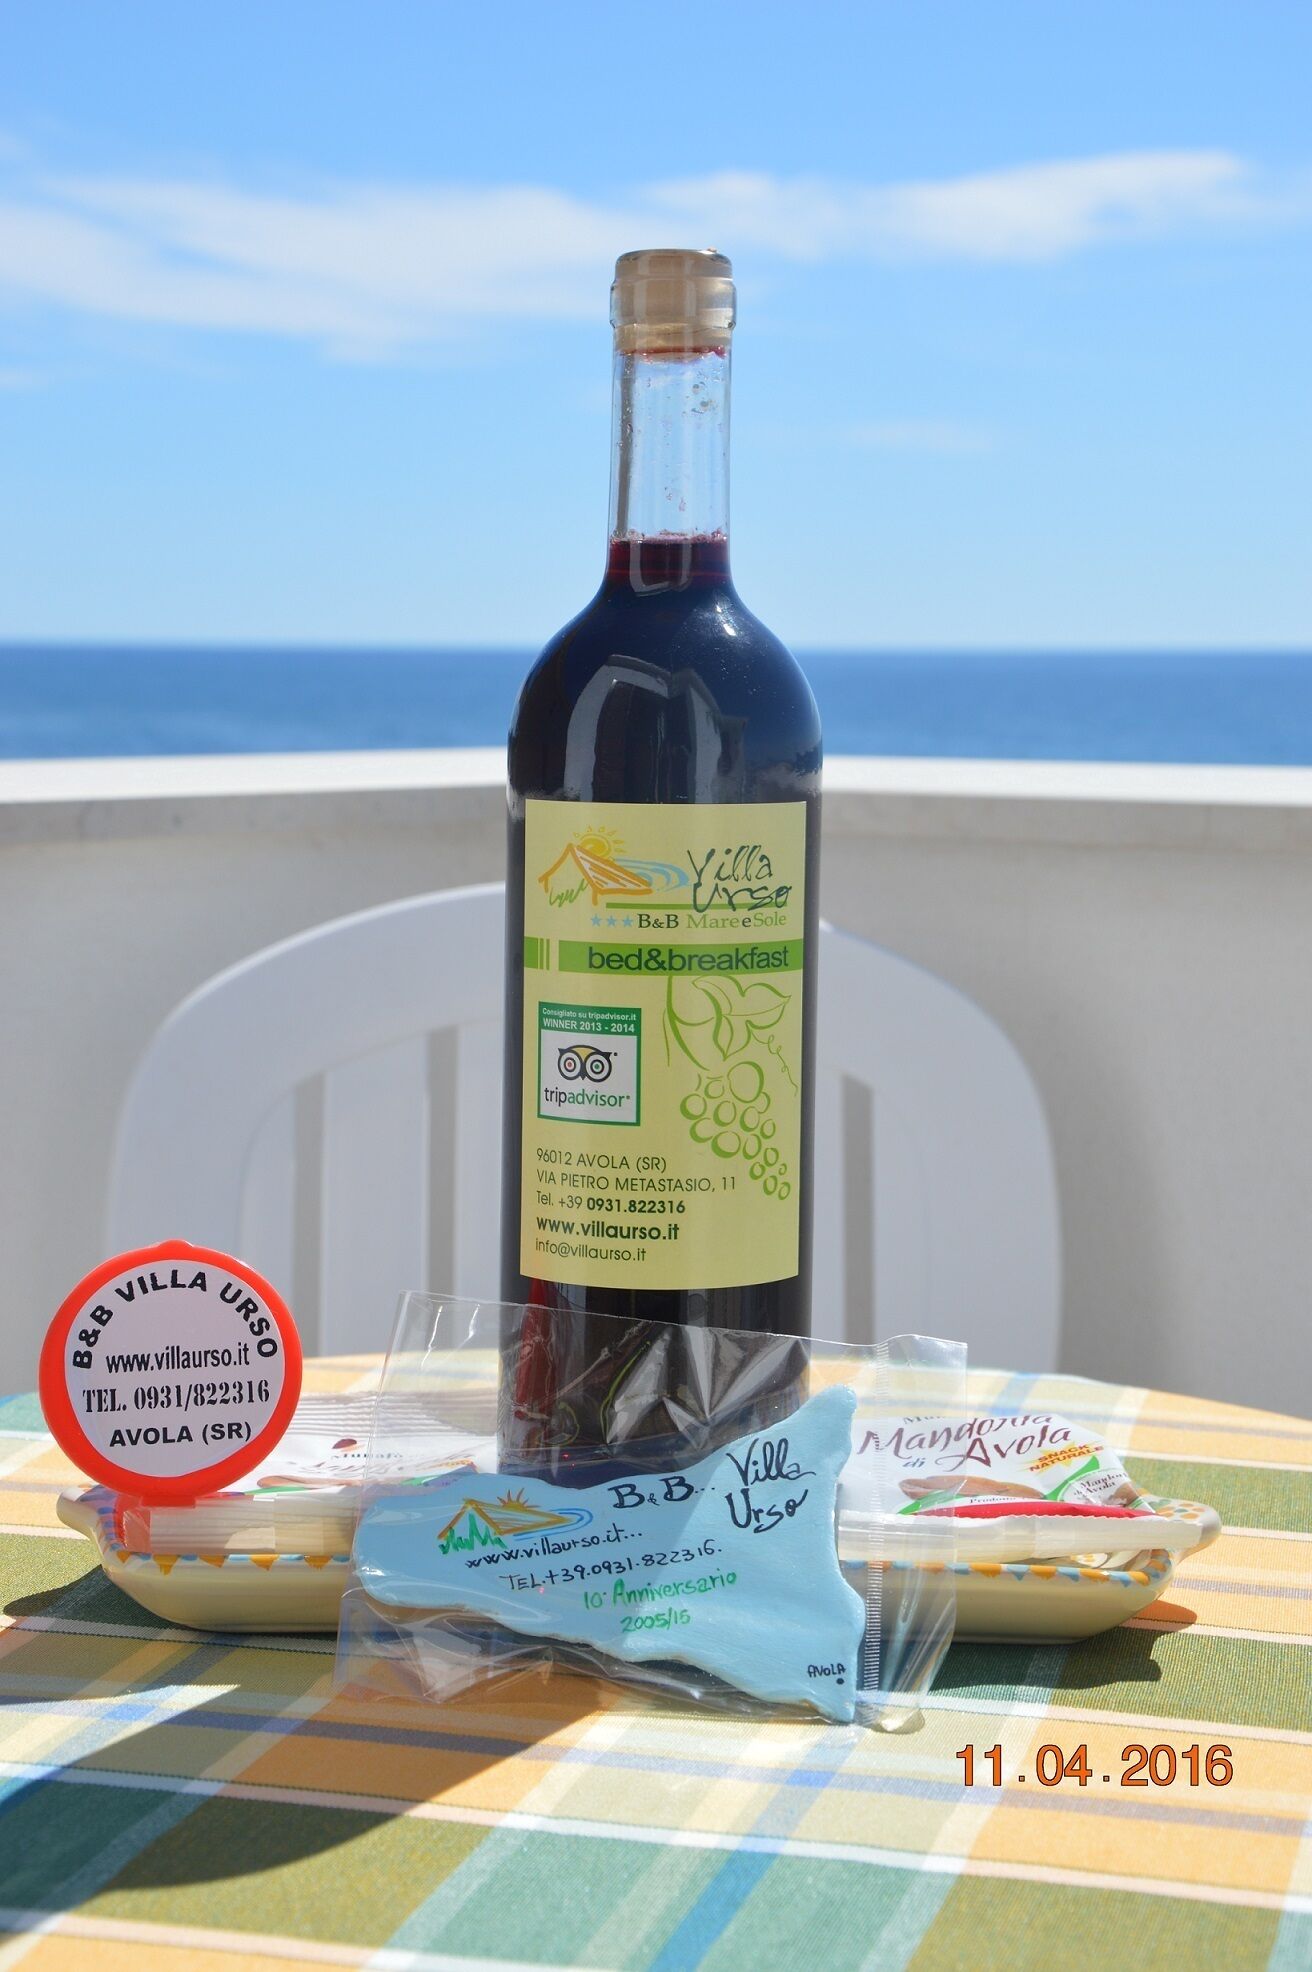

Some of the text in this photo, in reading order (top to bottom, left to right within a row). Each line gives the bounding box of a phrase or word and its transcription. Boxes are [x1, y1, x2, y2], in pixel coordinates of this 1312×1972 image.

[687, 844, 773, 882] Villa
[692, 881, 793, 913] Urso
[637, 913, 679, 929] B&B
[686, 912, 740, 929] Mare
[753, 911, 787, 927] Sole
[588, 946, 789, 972] bed&breakfast
[542, 1007, 577, 1018] Consigliato
[588, 1012, 637, 1021] tripadvisor.it
[543, 1017, 578, 1030] WINNER
[579, 1021, 602, 1032] 2013
[610, 1023, 635, 1033] 2014
[544, 1086, 625, 1107] tripadvisor
[536, 1147, 667, 1173] 96012 AVOLA (SR)
[536, 1168, 736, 1193] VIA PIETRO METASTASIO, 11
[536, 1190, 686, 1214] Tel. +39 0931.822316
[536, 1216, 680, 1241] www.villaurso.it
[535, 1237, 647, 1262] info@villaurso.it
[72, 1269, 278, 1370] B&B VILLA URSO
[106, 1342, 250, 1373] www.villaurso.it
[82, 1379, 270, 1413] TEL. 0931/822316
[109, 1421, 251, 1447] AVOLA (SR)
[935, 1424, 1072, 1472] Avola
[725, 1437, 817, 1487] Villa
[724, 1487, 809, 1534] Urso
[612, 1567, 737, 1607] Anniversario
[620, 1608, 691, 1633] 2005/15
